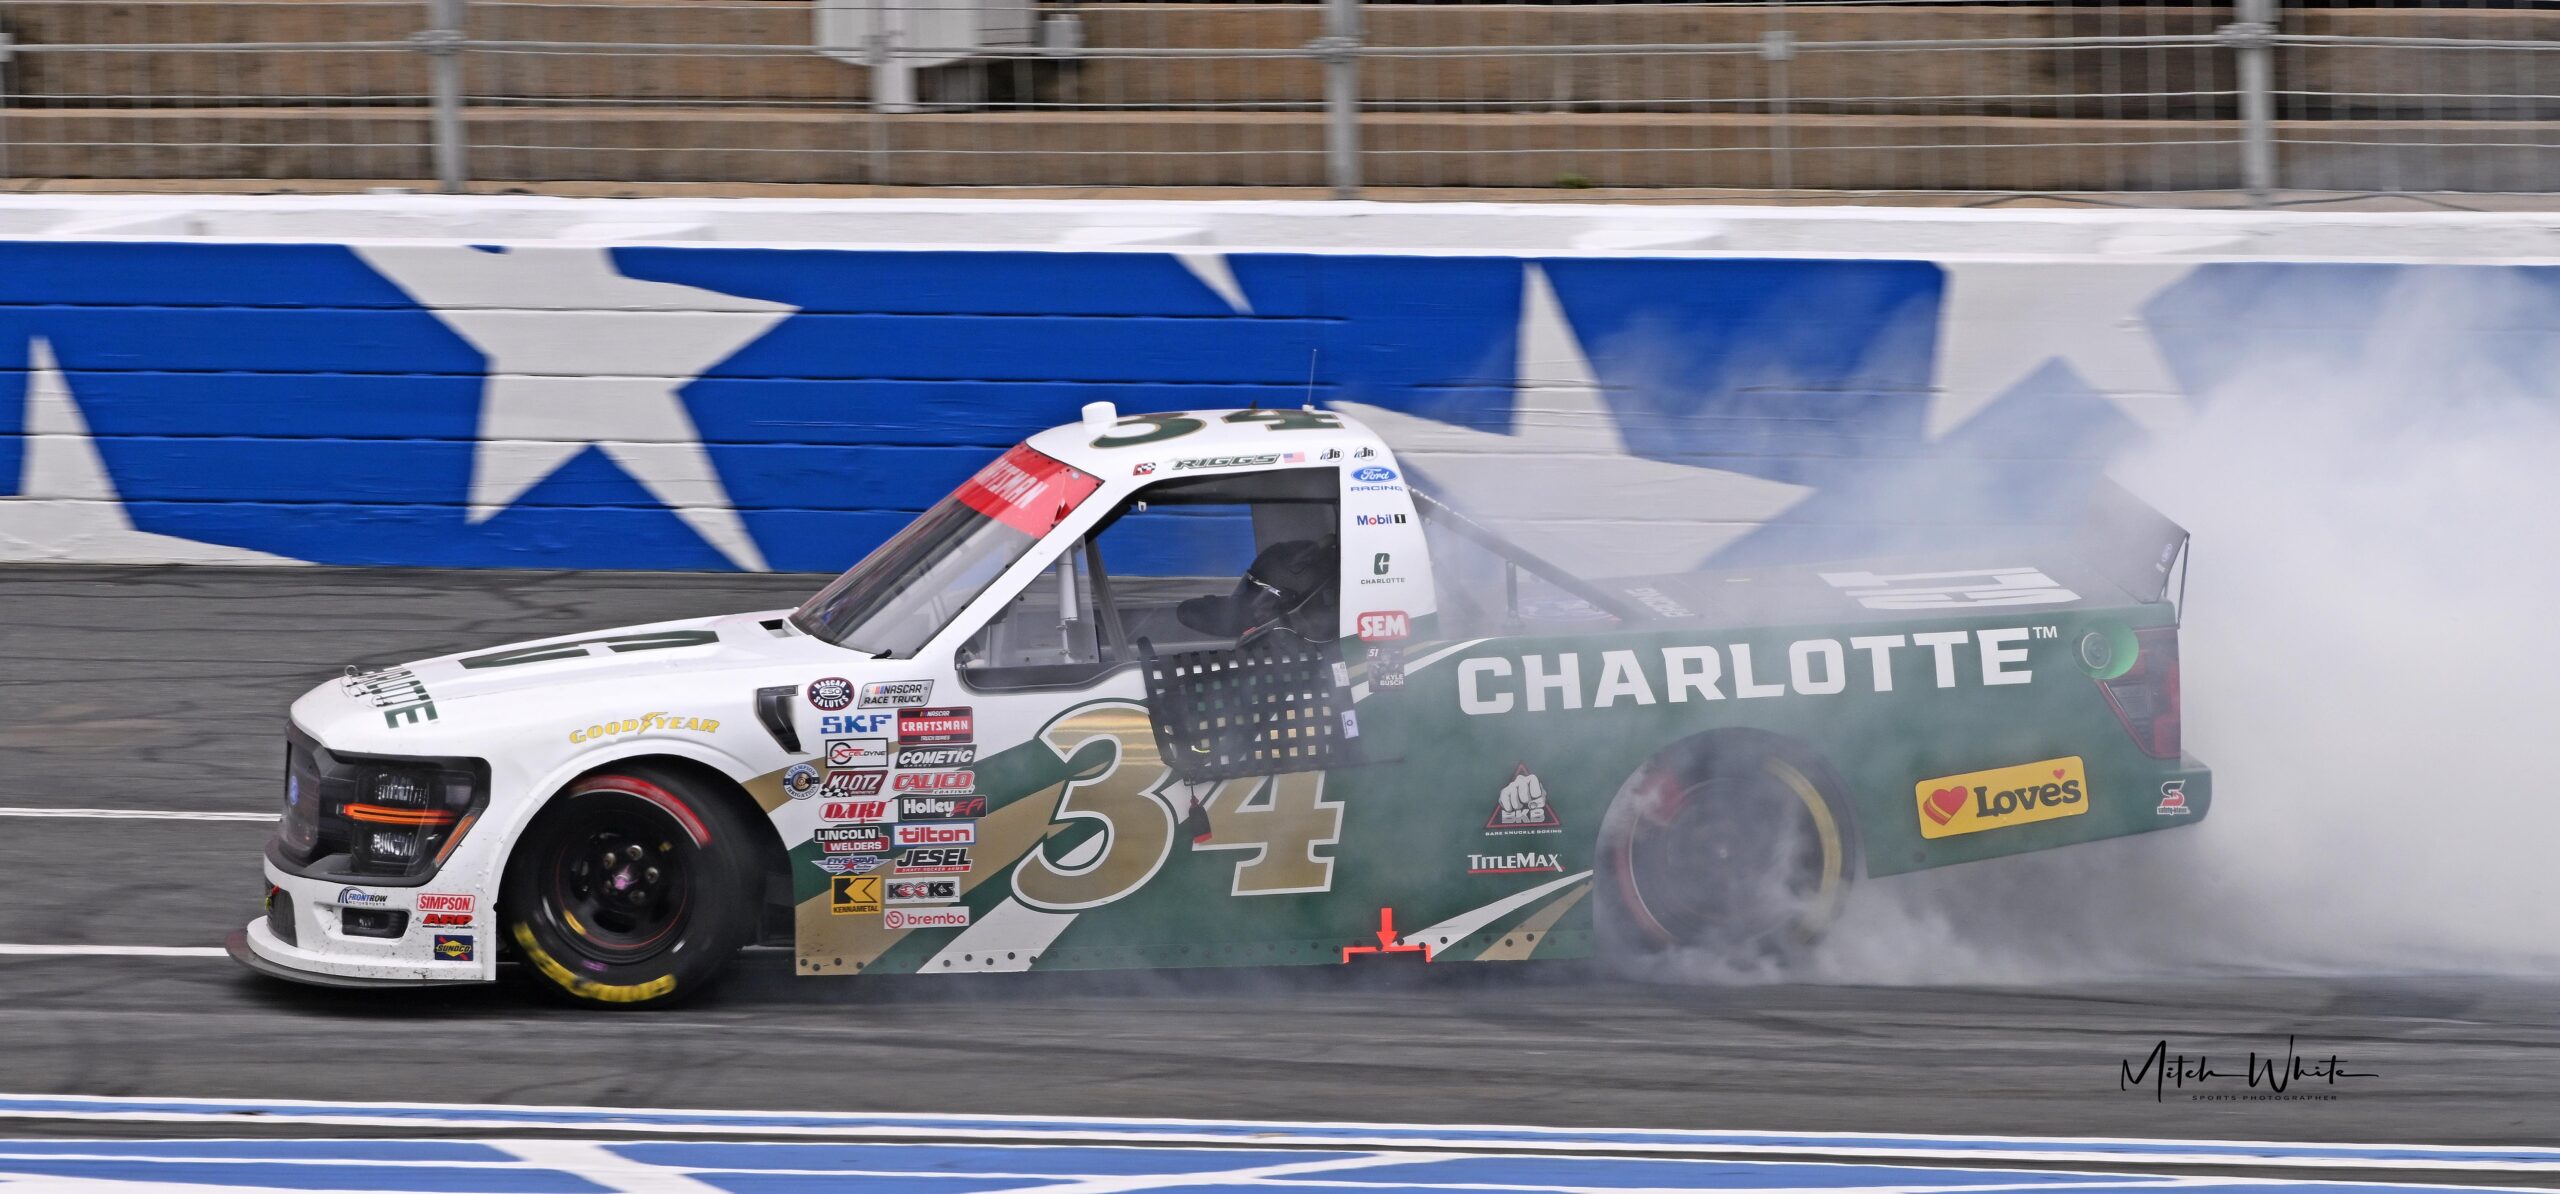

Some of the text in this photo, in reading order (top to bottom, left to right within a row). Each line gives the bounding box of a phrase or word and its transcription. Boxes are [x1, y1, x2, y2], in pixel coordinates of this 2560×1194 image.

[1089, 408, 1345, 448] 34
[1172, 453, 1281, 470] RIGGS
[1360, 468, 1390, 480] Ford
[1357, 514, 1392, 526] Mobil
[1360, 577, 1405, 585] CHARLOTTE
[1360, 614, 1407, 638] SEM
[1368, 648, 1379, 657] 51
[1385, 673, 1404, 681] KYLE
[1457, 627, 2033, 716] CHARLOTTE
[813, 679, 847, 690] NASCAR
[883, 684, 922, 694] NASCAR
[813, 695, 849, 708] SALUTES
[863, 695, 923, 704] RACE TRUCK
[569, 712, 720, 744] GOODYEAR
[820, 714, 893, 735] SKF
[901, 720, 968, 732] CRAFTSMAN
[899, 749, 973, 766] COMETIC
[829, 774, 883, 791] KLOTZ
[894, 771, 974, 790] CALICO
[903, 799, 954, 817] Holley
[1010, 701, 1345, 911] 34
[816, 828, 877, 841] LINCOLN
[899, 826, 970, 843] tilton
[830, 841, 882, 851] WELDERS
[826, 856, 876, 865] FIVE STAR
[896, 848, 972, 866] JESEL
[887, 881, 956, 899] KOOKS
[419, 896, 471, 911] SIMPSON
[833, 905, 879, 914] KENNAMETAL
[422, 913, 473, 926] ARP
[907, 912, 966, 925] brembo
[436, 943, 472, 953] SUNOCO
